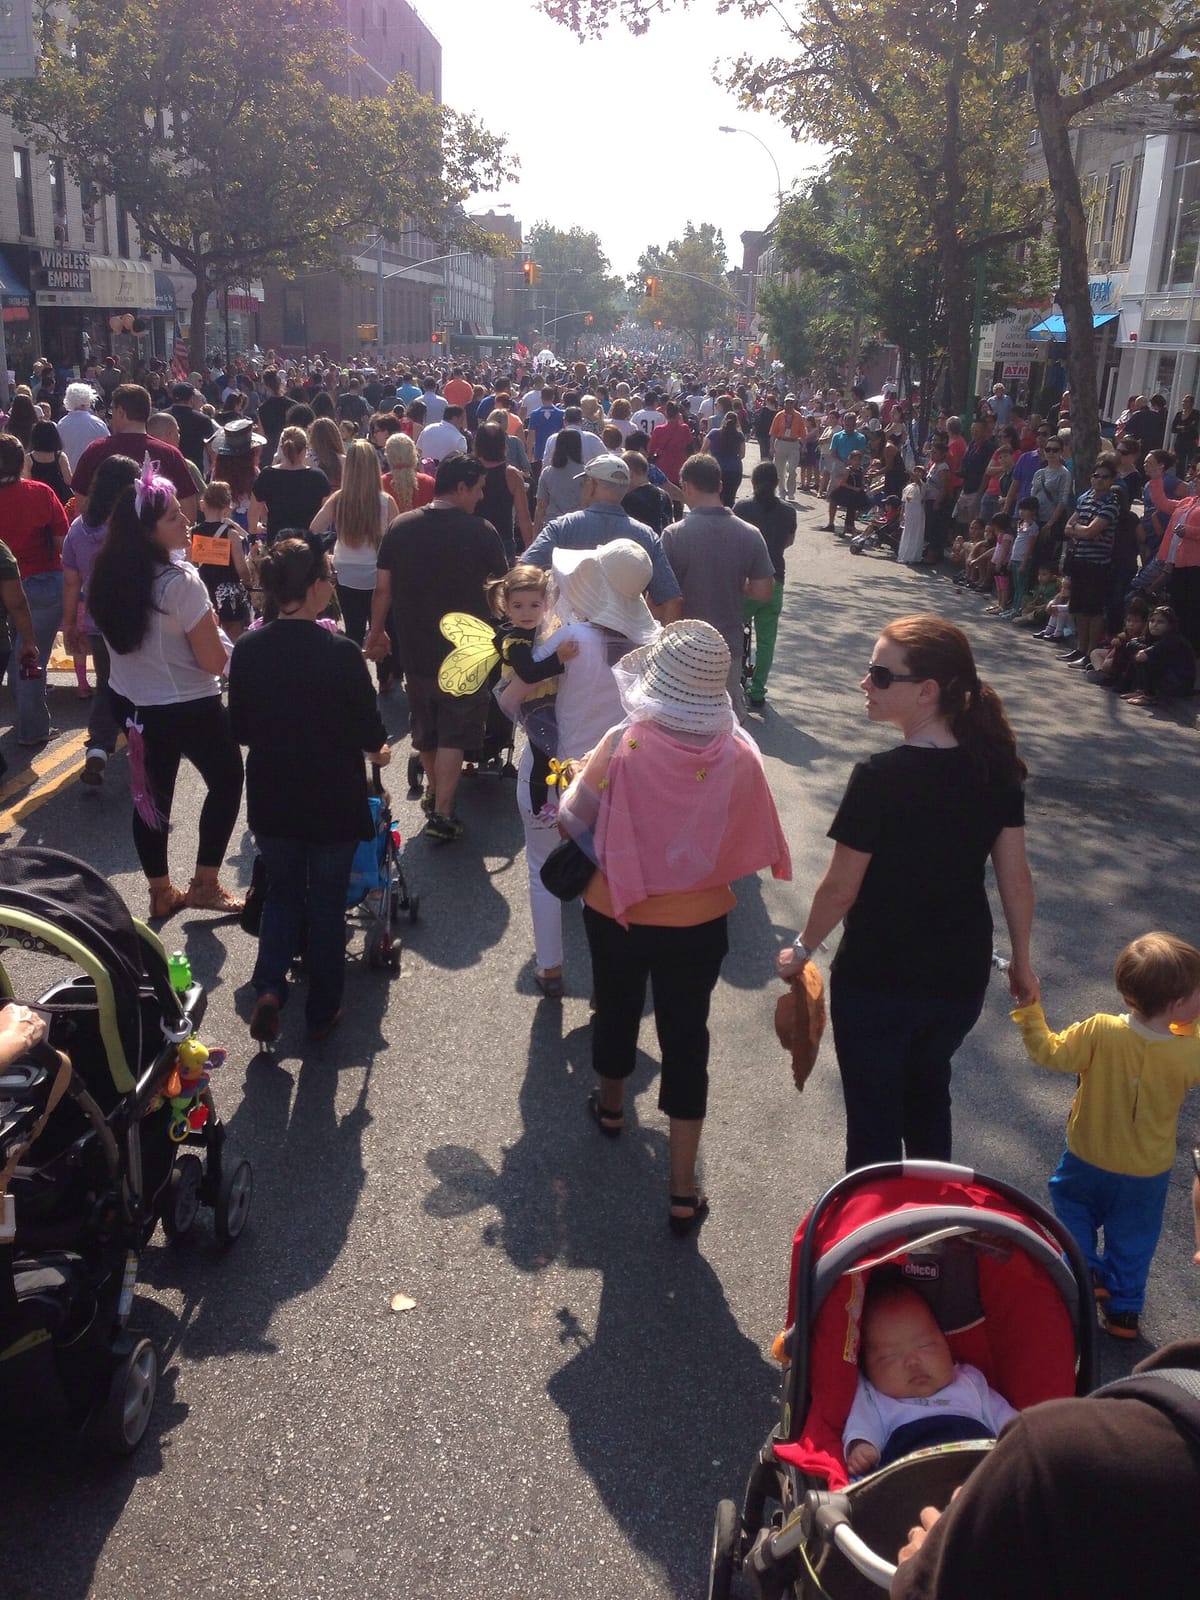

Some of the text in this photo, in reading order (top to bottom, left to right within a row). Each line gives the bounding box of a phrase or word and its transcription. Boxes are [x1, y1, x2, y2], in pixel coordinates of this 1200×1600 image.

[40, 250, 91, 270] WIRELESS
[47, 270, 84, 288] EMPIRE
[1004, 366, 1029, 375] ATM
[905, 1263, 937, 1277] chicco
